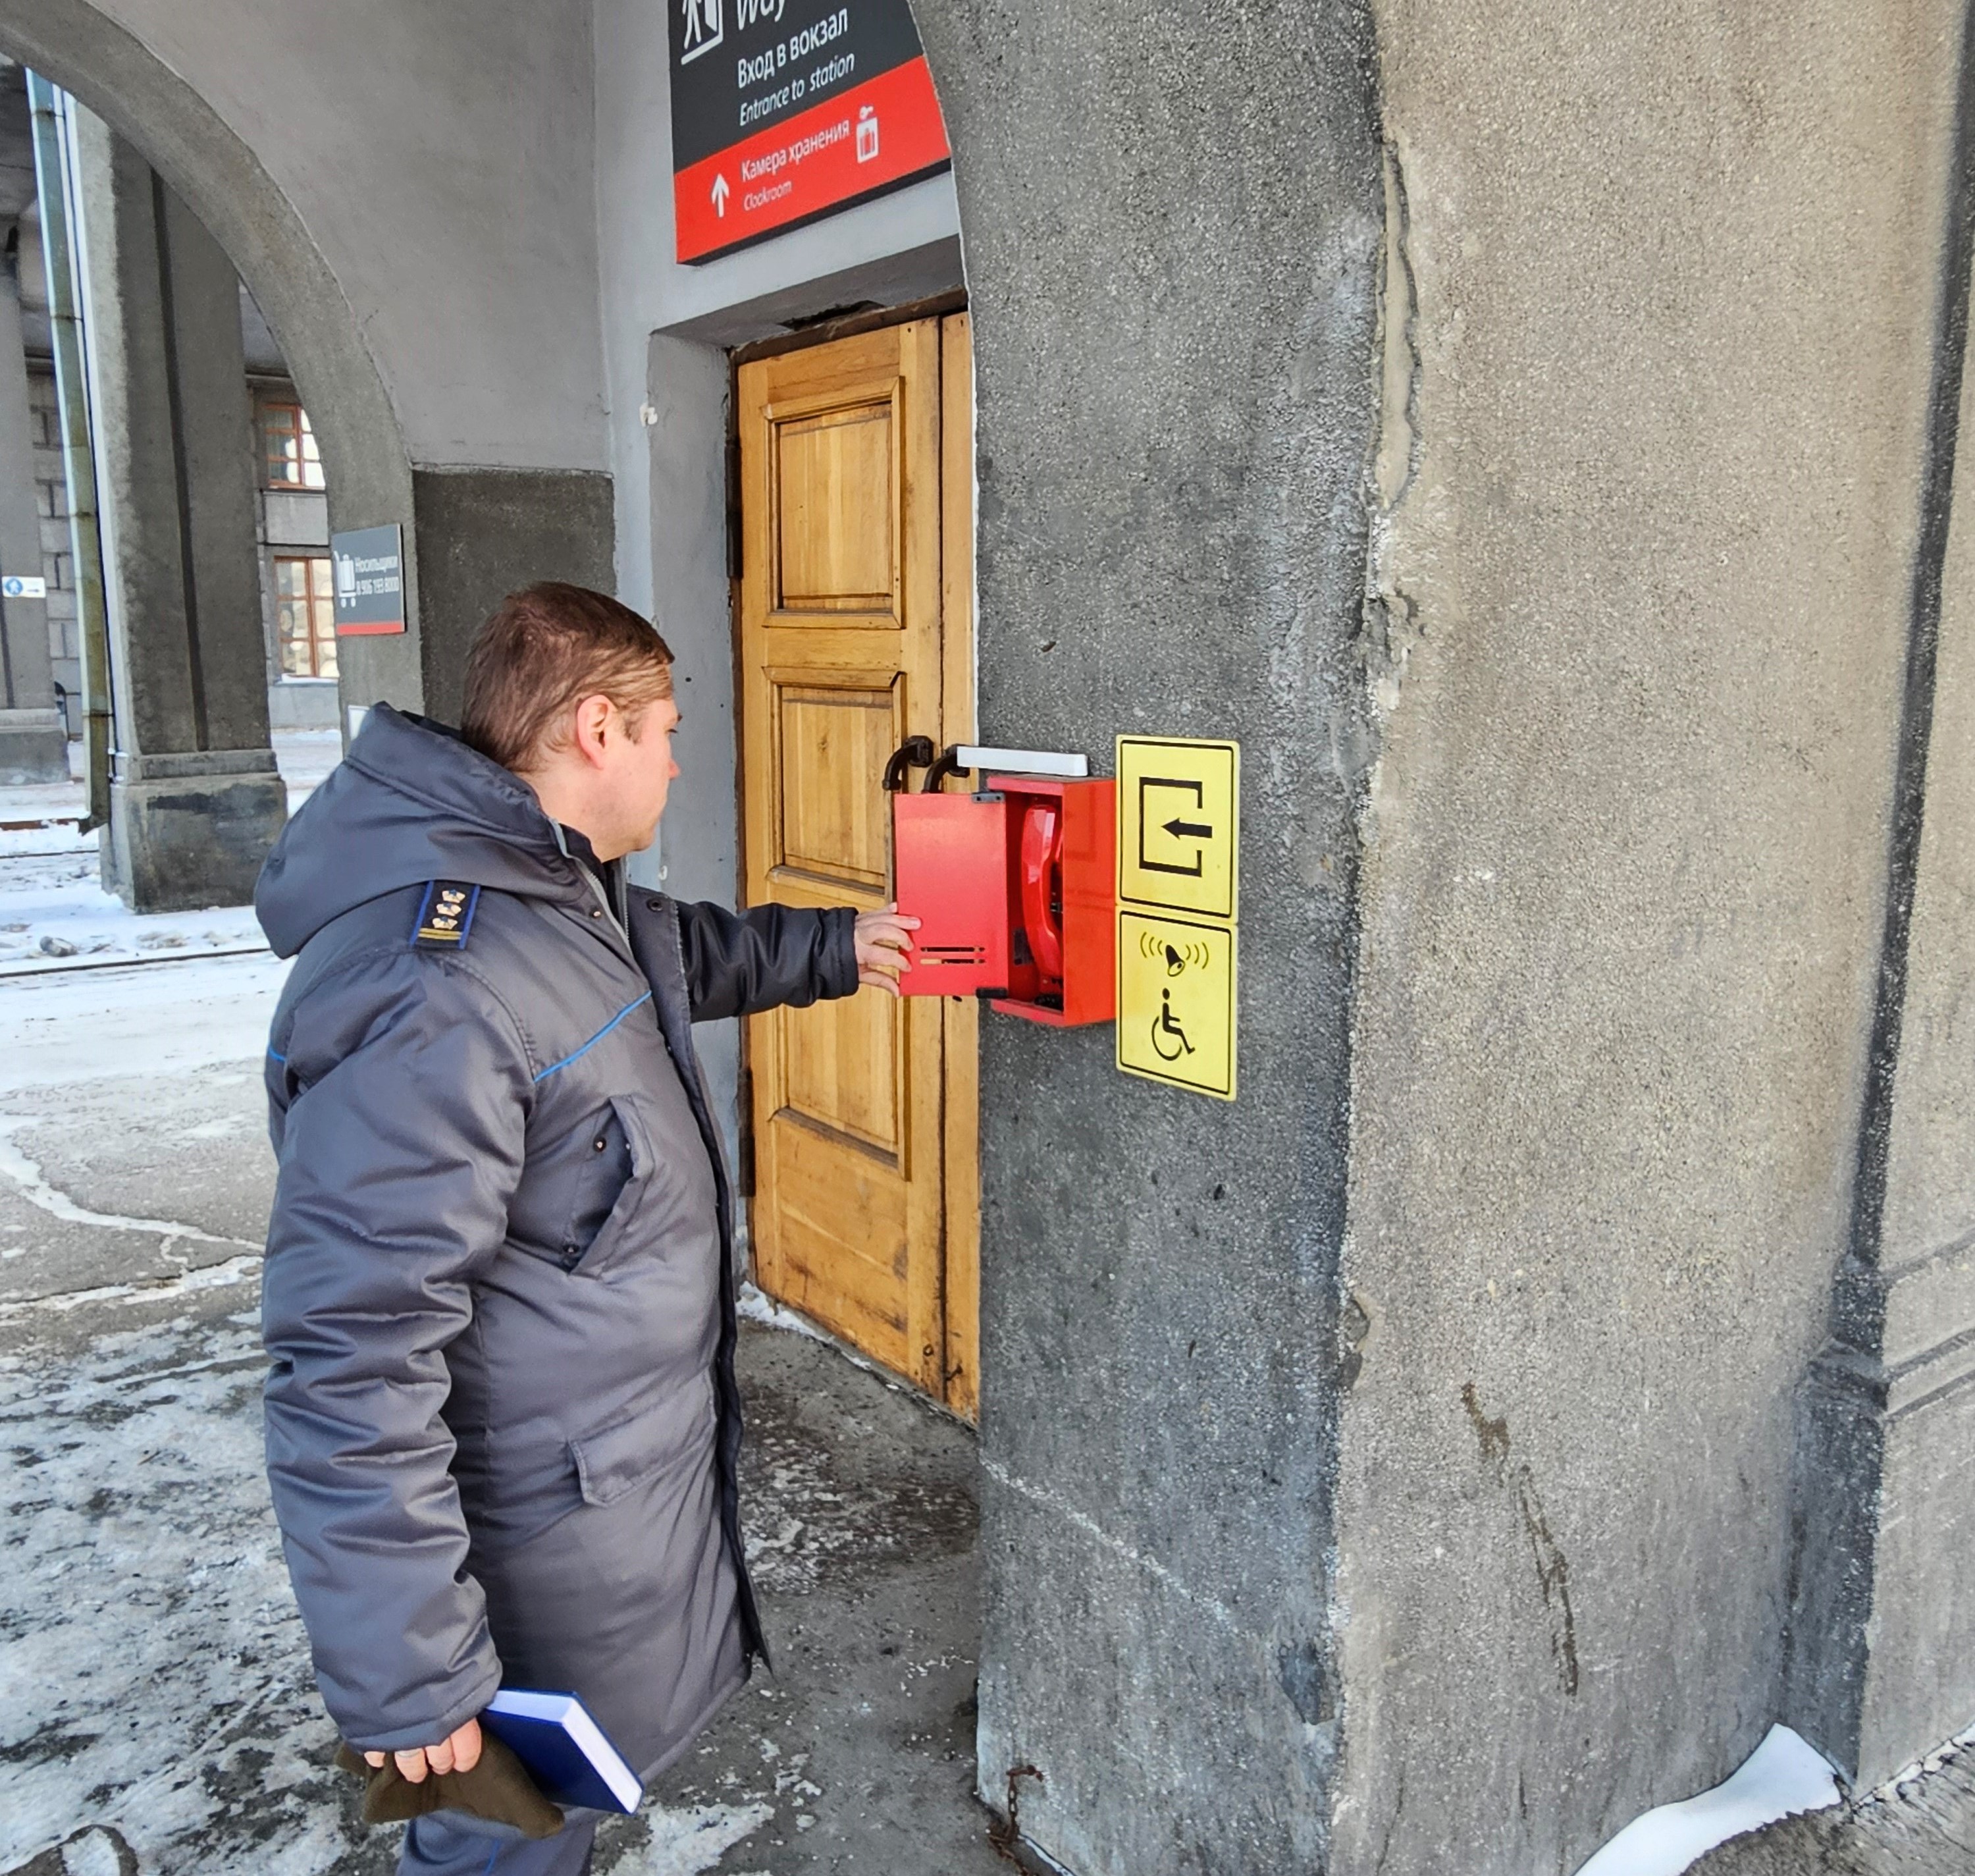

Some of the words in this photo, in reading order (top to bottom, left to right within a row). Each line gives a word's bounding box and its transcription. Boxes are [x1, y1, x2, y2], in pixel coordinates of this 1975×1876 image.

[738, 58, 775, 89] Вход
[776, 43, 786, 68] в
[790, 8, 848, 61] вокзал
[739, 86, 789, 126] Entrance
[791, 79, 804, 100] to
[809, 53, 855, 92] station
[741, 149, 787, 182] Камера
[788, 119, 850, 165] хранения
